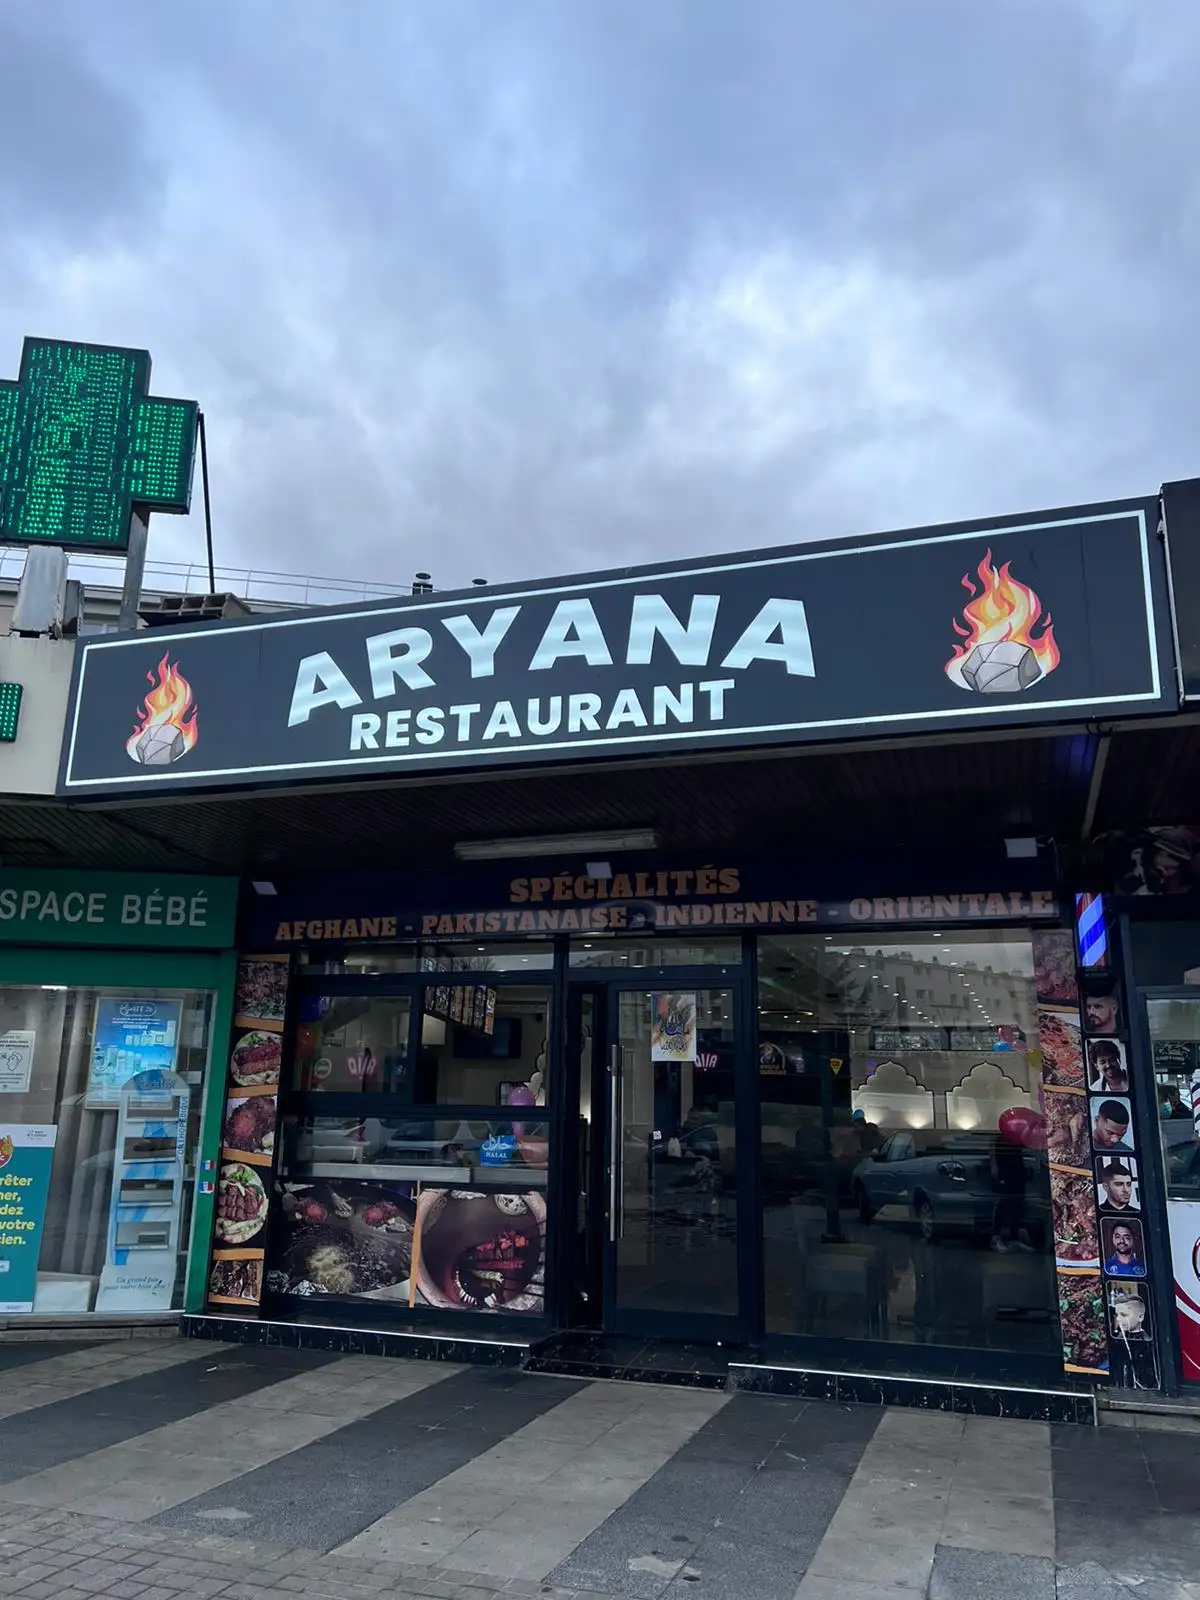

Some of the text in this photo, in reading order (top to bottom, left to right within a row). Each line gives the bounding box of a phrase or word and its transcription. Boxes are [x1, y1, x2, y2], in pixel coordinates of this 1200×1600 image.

[287, 594, 816, 728] ARYANA
[350, 679, 735, 751] RESTAURANT
[510, 863, 740, 903] SPÉCIALITÉS
[0, 889, 208, 926] SPACE BÉBÉ
[275, 916, 397, 941] AFGHANE
[421, 906, 627, 935] PAKISTANAISE
[656, 899, 817, 927] INDIENNE
[849, 891, 1053, 920] ORIENTALE
[486, 1151, 508, 1159] HALAL
